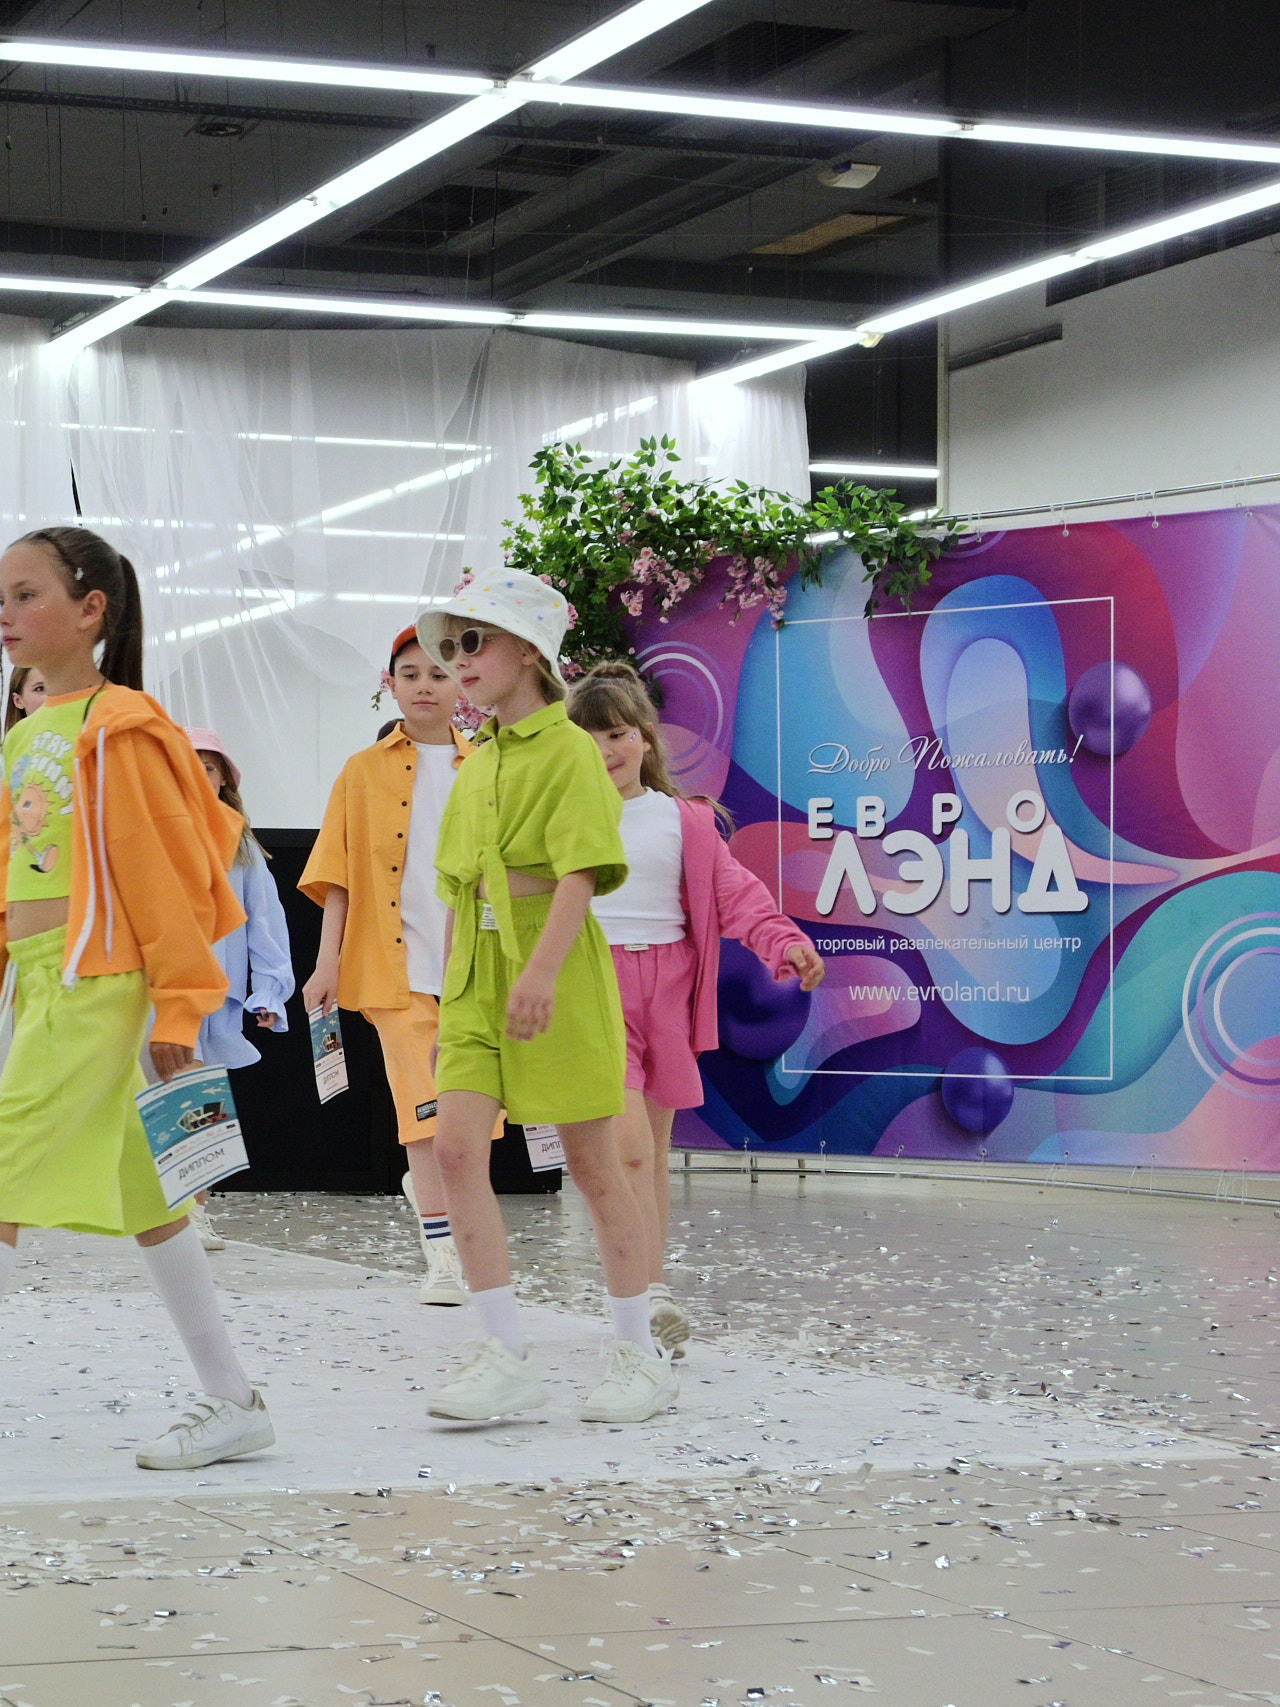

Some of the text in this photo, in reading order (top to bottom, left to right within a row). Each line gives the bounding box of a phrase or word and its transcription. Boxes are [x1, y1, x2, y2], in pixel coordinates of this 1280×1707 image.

[31, 731, 73, 759] STAY
[806, 734, 1085, 781] Добро Пожаловать!
[815, 824, 1089, 915] ЛЭНД
[816, 935, 1082, 953] торговый развлекательный центр
[849, 980, 1031, 1002] www.evroland.ru
[541, 1141, 561, 1153] ДИПЛ
[178, 1148, 224, 1179] ДИПЛОМ
